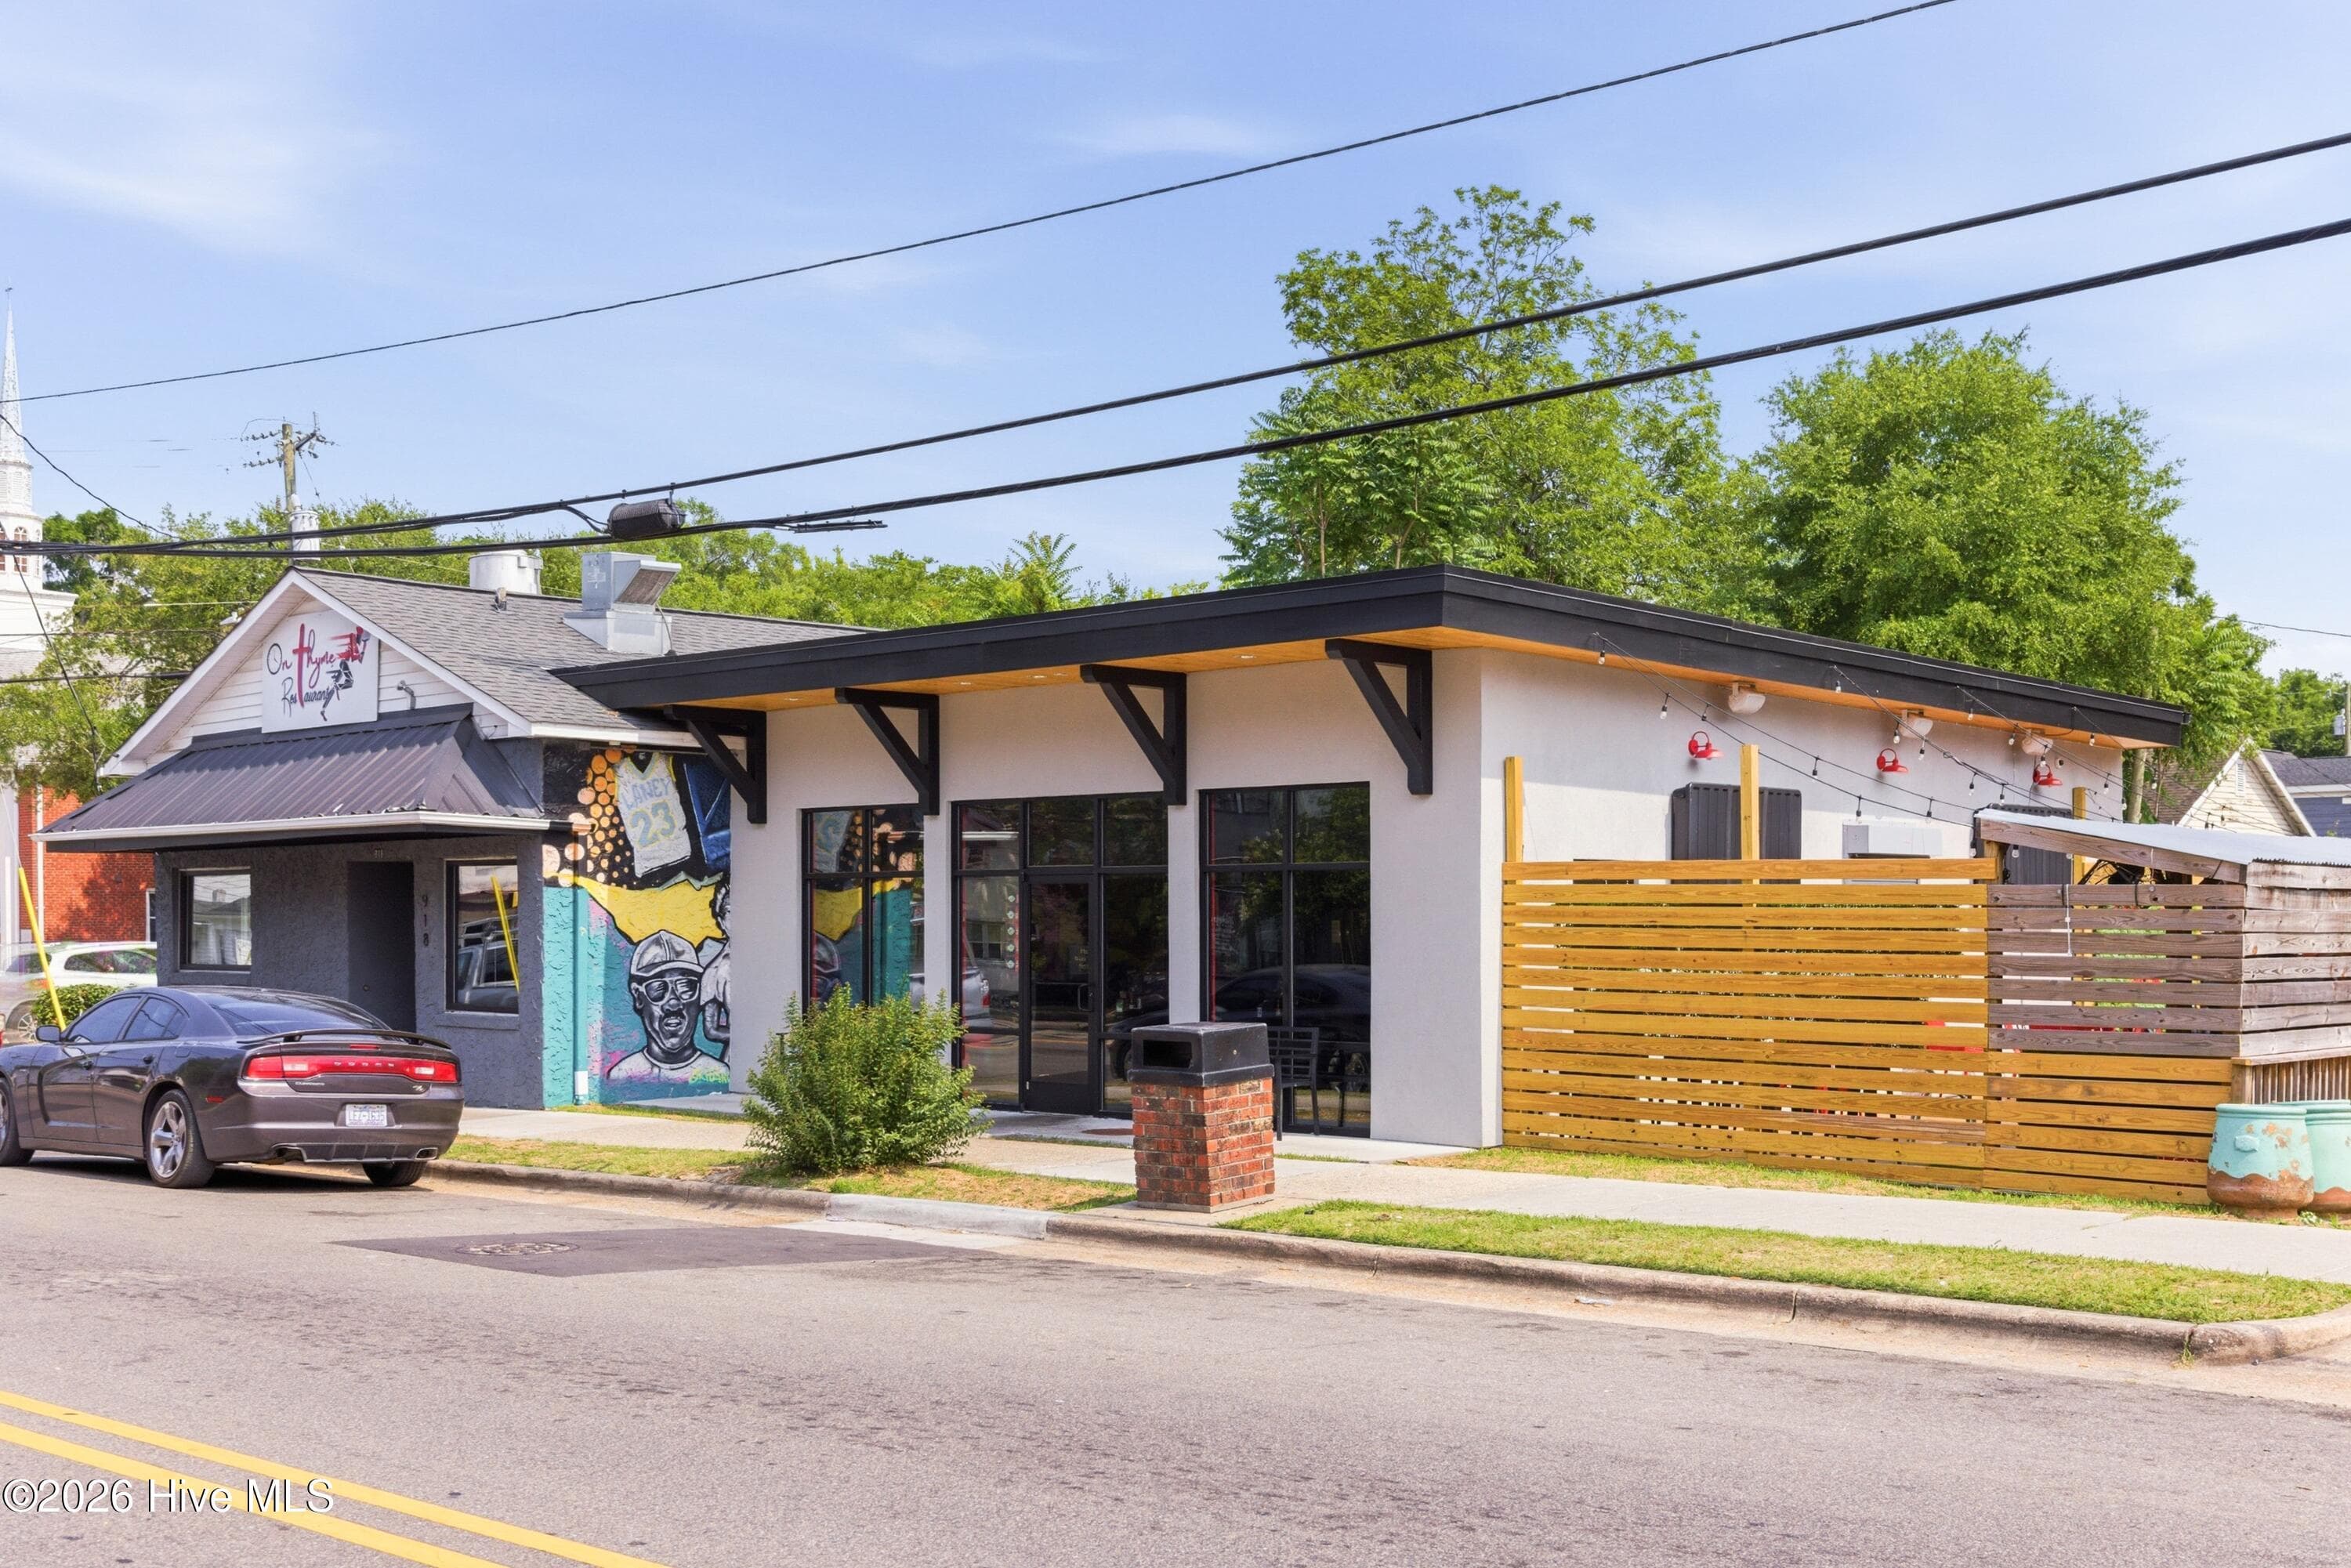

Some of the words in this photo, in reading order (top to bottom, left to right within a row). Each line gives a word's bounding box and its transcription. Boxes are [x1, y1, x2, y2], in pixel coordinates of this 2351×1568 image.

[266, 643, 293, 675] On
[292, 623, 337, 708] thyme
[620, 776, 672, 812] LANEY
[630, 799, 676, 849] 23
